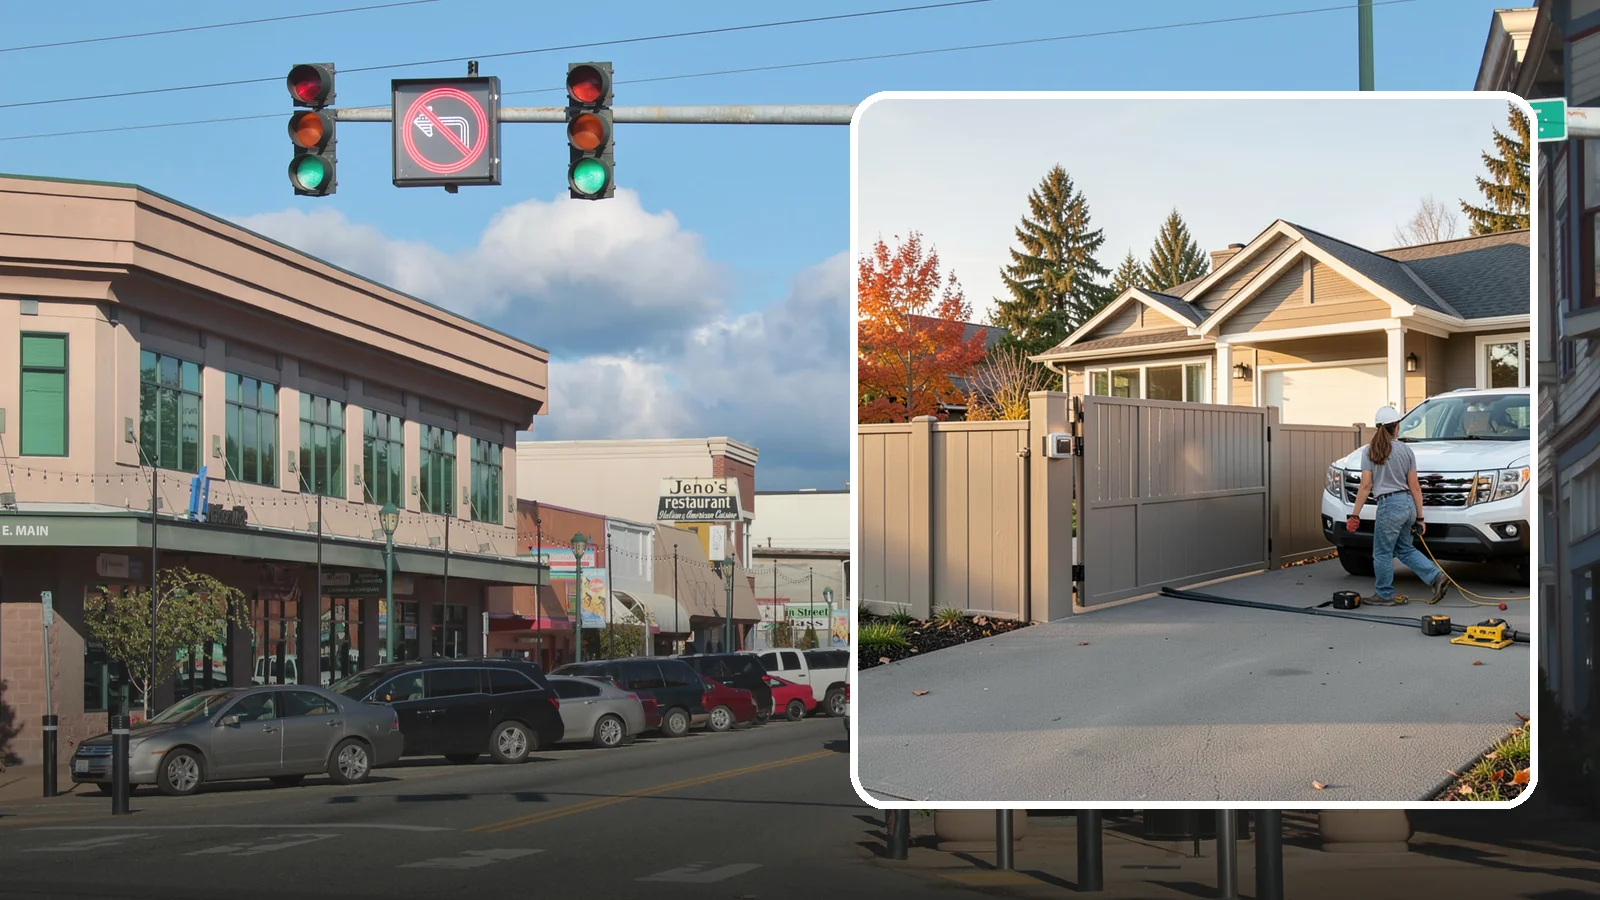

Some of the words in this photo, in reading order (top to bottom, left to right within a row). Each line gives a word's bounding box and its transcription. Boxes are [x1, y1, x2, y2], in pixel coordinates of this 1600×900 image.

[670, 480, 728, 494] Jeno's
[665, 497, 731, 509] restaurant
[659, 510, 682, 519] Italian
[686, 510, 714, 519] American
[715, 510, 737, 519] Cuisine
[2, 525, 13, 536] E.
[15, 525, 49, 536] MAIN
[797, 608, 828, 617] Street
[791, 619, 824, 627] lass
